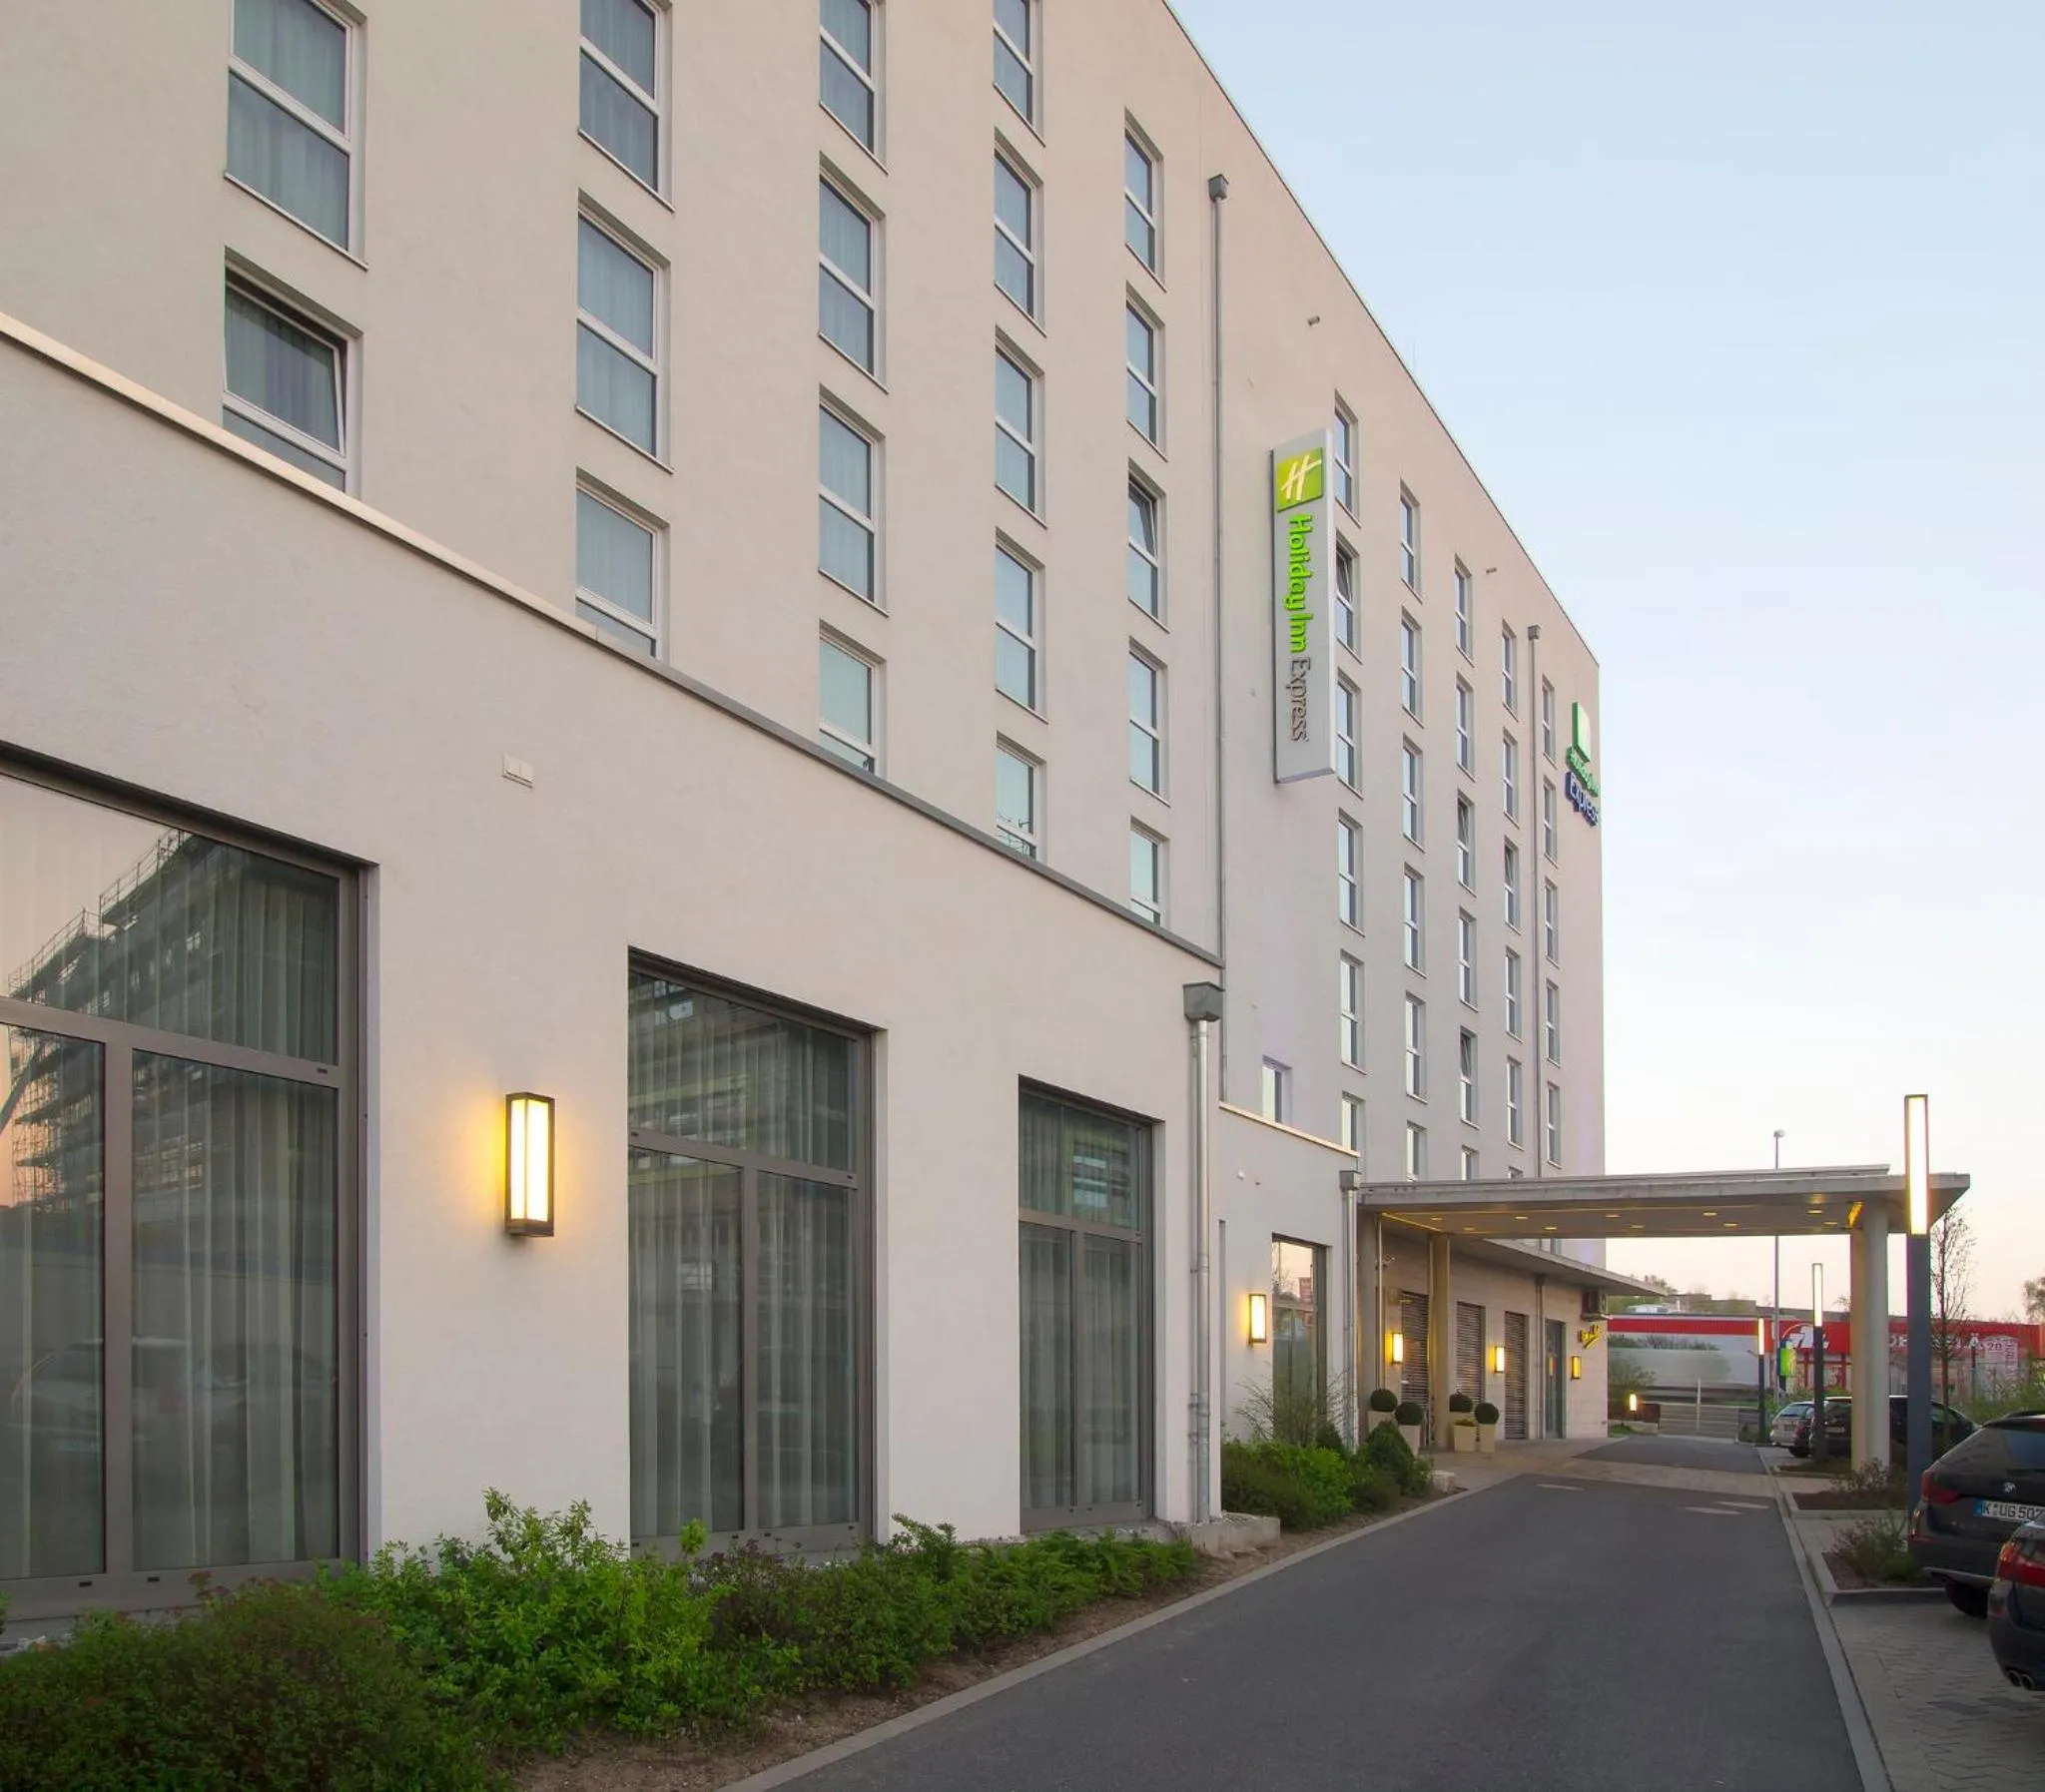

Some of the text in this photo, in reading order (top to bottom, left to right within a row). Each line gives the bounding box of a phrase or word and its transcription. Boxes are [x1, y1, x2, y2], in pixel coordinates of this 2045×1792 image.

[1284, 514, 1314, 742] Holiday Inn Express
